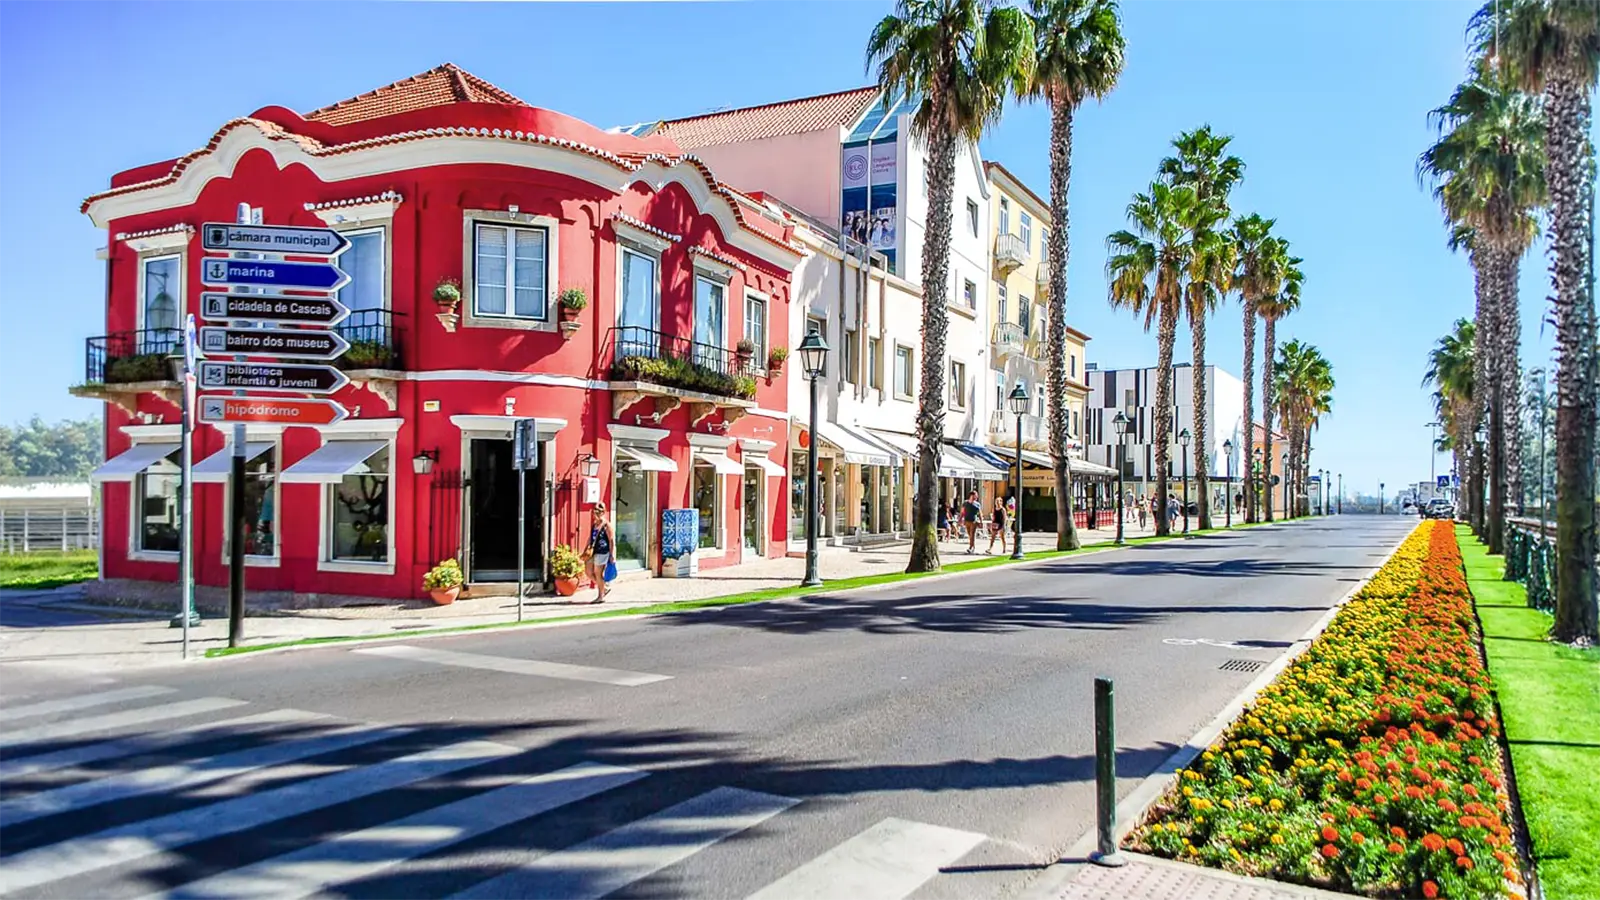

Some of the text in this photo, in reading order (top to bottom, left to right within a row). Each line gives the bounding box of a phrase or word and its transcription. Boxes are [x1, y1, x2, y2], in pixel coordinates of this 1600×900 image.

[229, 231, 331, 247] câmara municipal
[229, 266, 275, 278] marina
[228, 300, 331, 316] cidadela de Cascais
[227, 334, 330, 349] bairro dos museus
[227, 365, 283, 377] biblioteca
[227, 375, 318, 388] infantil e juvenil
[226, 404, 300, 417] hipódromo
